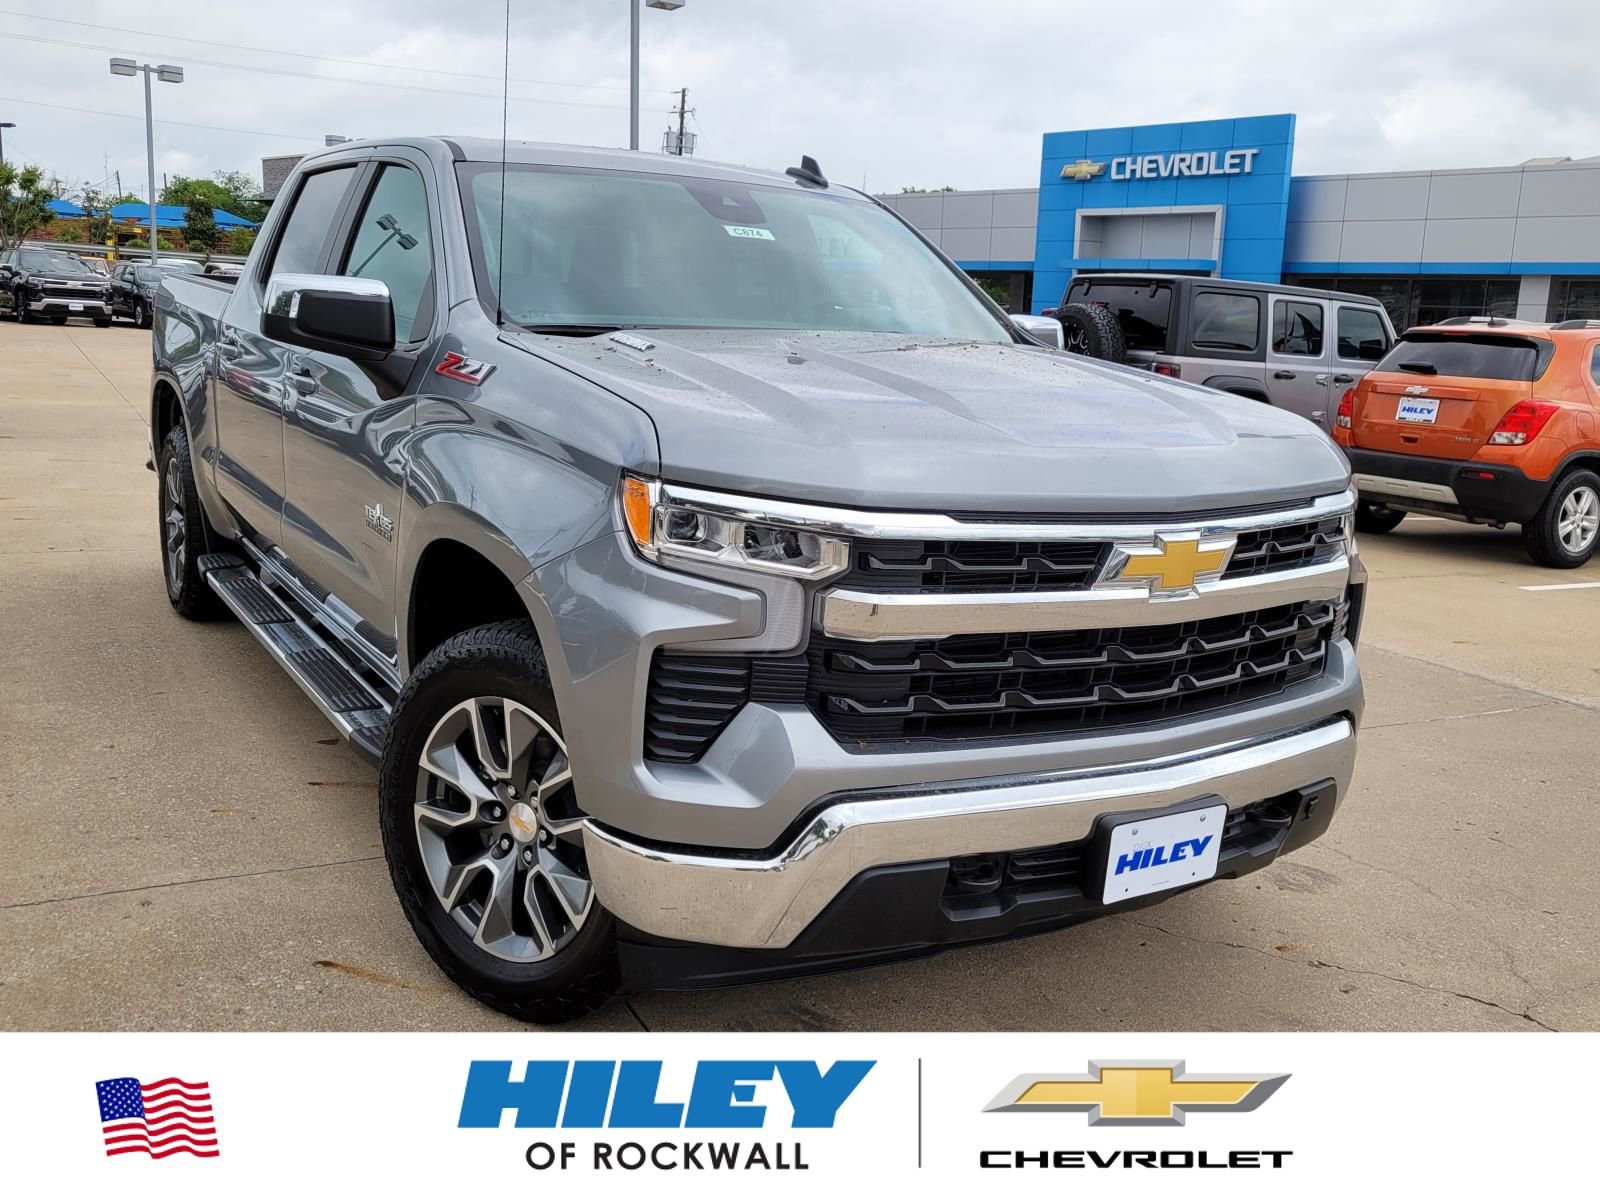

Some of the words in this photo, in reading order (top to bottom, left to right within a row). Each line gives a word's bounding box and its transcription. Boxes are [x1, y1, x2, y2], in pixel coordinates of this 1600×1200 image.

[1111, 149, 1258, 180] CHEVROLET
[733, 228, 763, 237] C874
[436, 351, 496, 386] Z71
[1402, 406, 1434, 414] HILEY
[1114, 834, 1214, 875] HILEY
